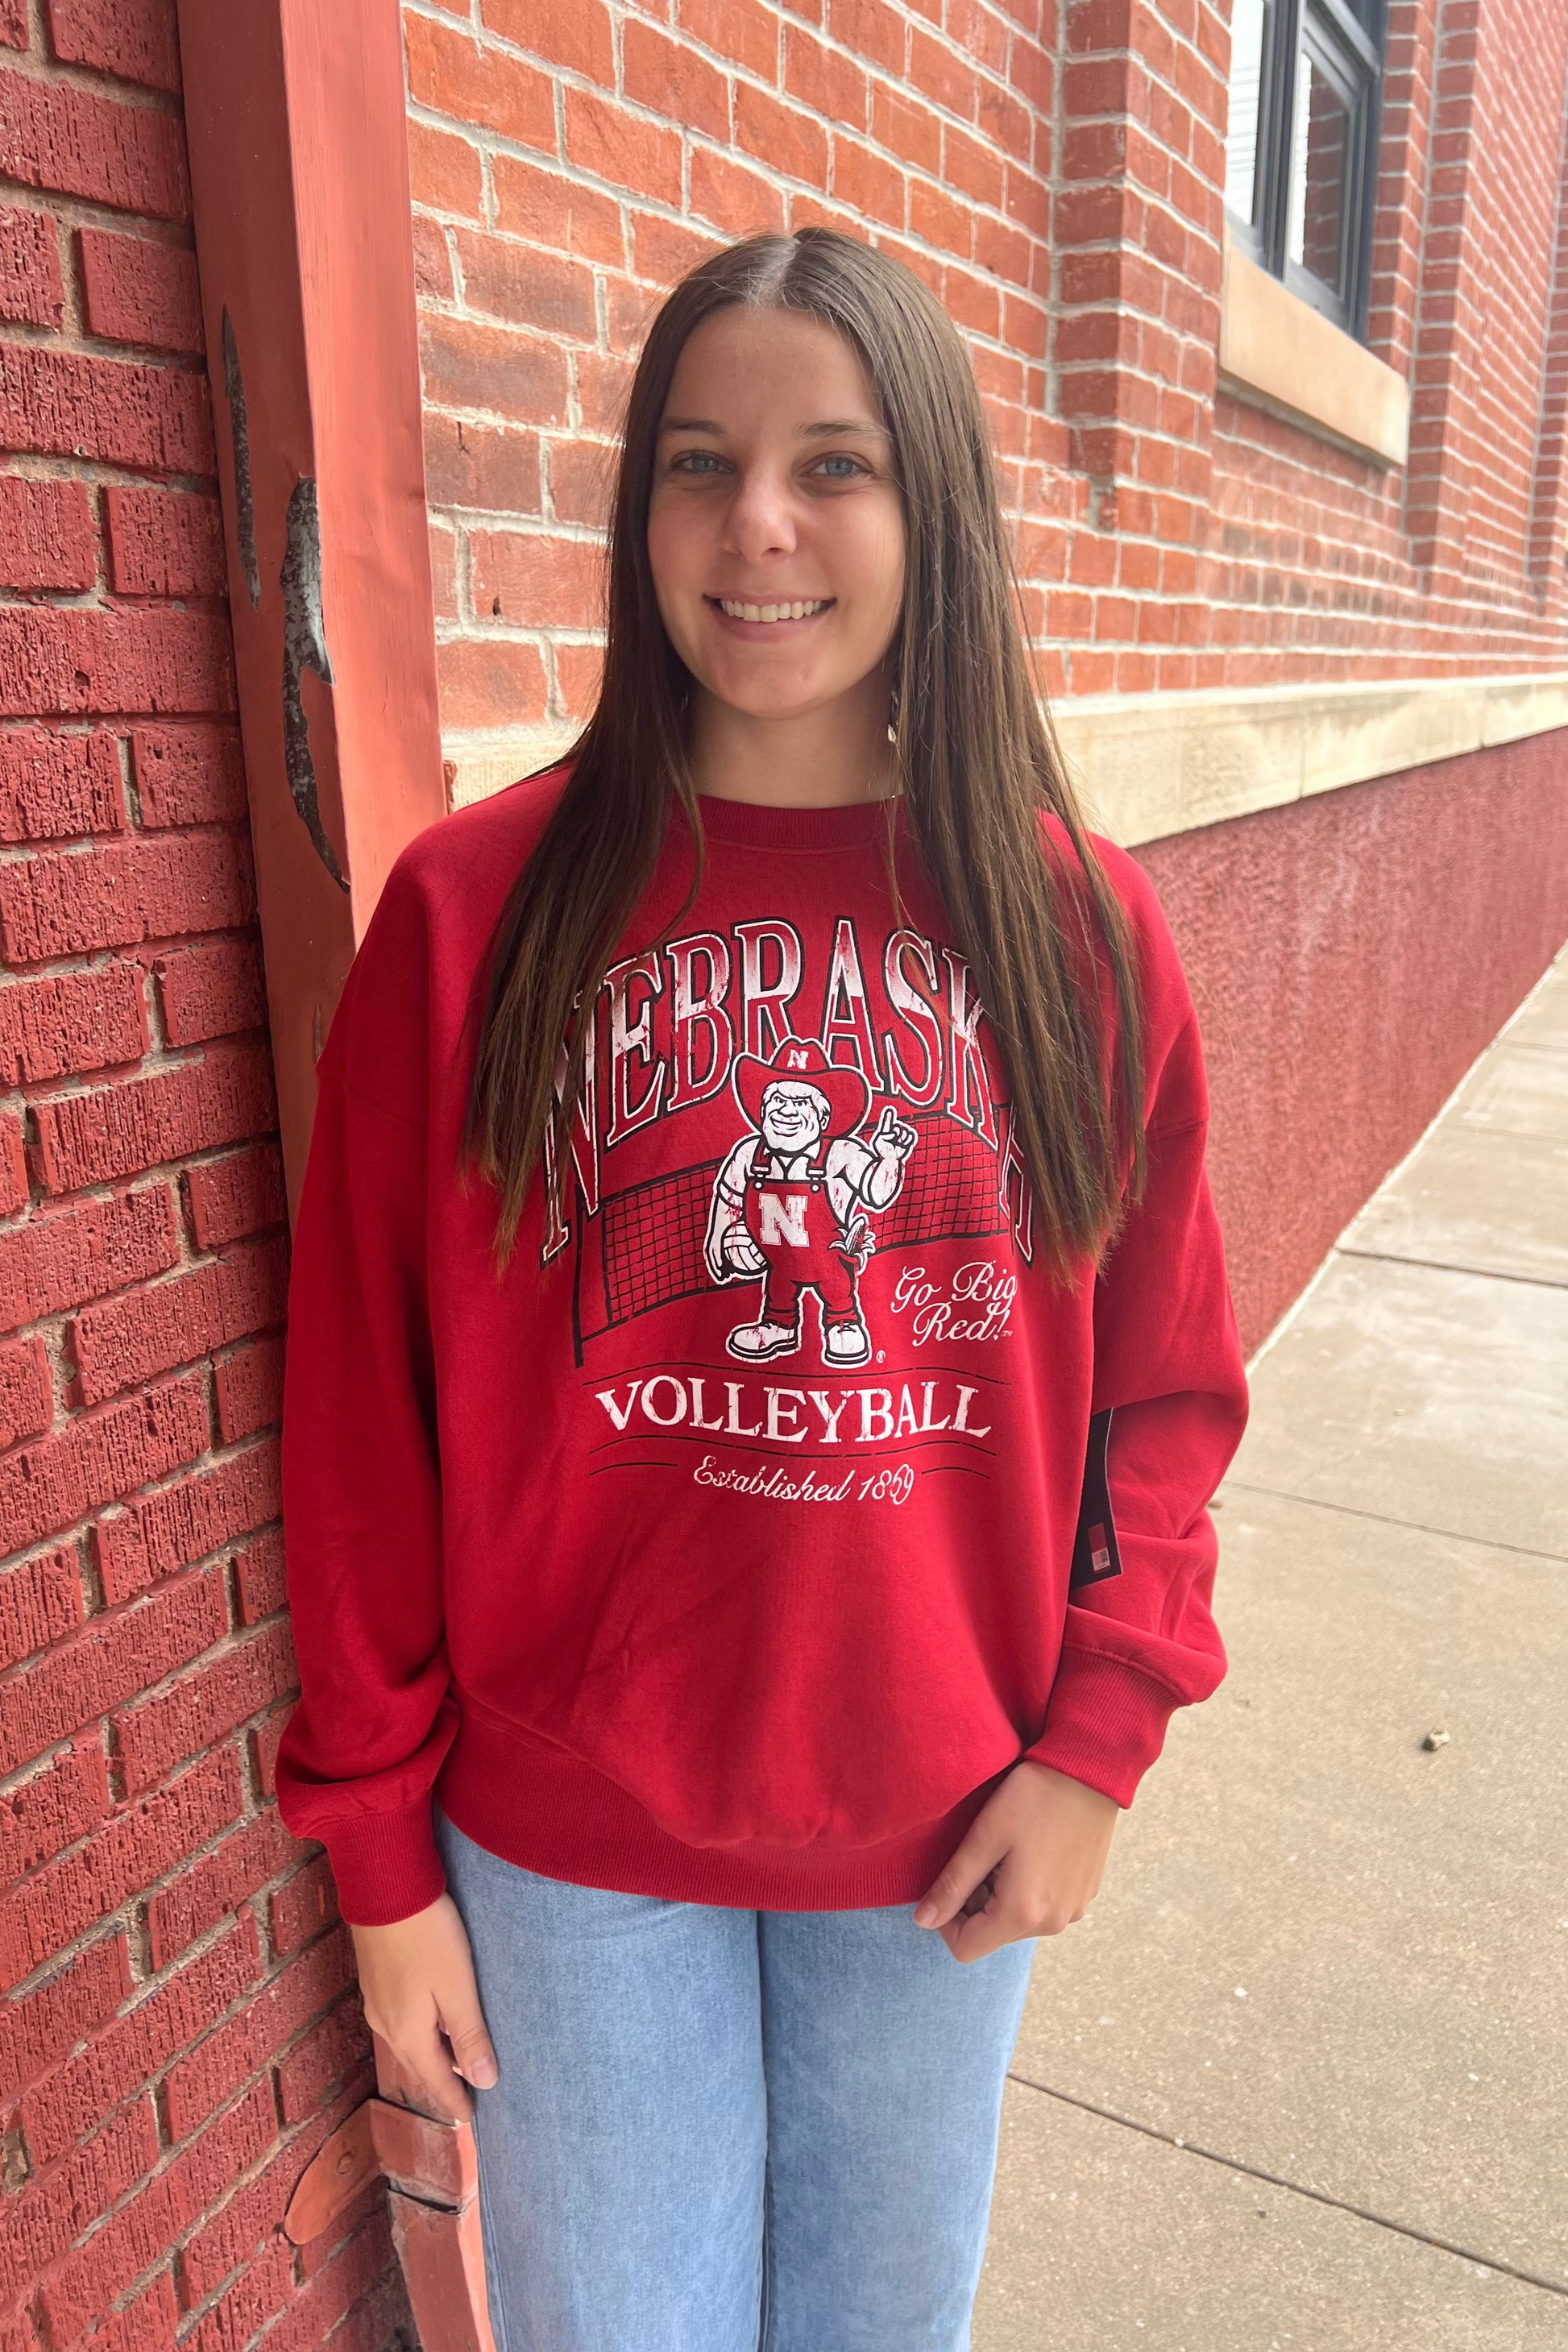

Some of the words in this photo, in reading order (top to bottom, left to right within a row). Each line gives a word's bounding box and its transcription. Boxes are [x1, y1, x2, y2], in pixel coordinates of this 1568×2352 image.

[786, 1049, 809, 1070] N
[759, 1193, 810, 1247] N
[890, 1265, 942, 1313] Go
[951, 1259, 1018, 1316] Big
[595, 1375, 993, 1444] VOLLEYBALL
[693, 1454, 857, 1502] Established
